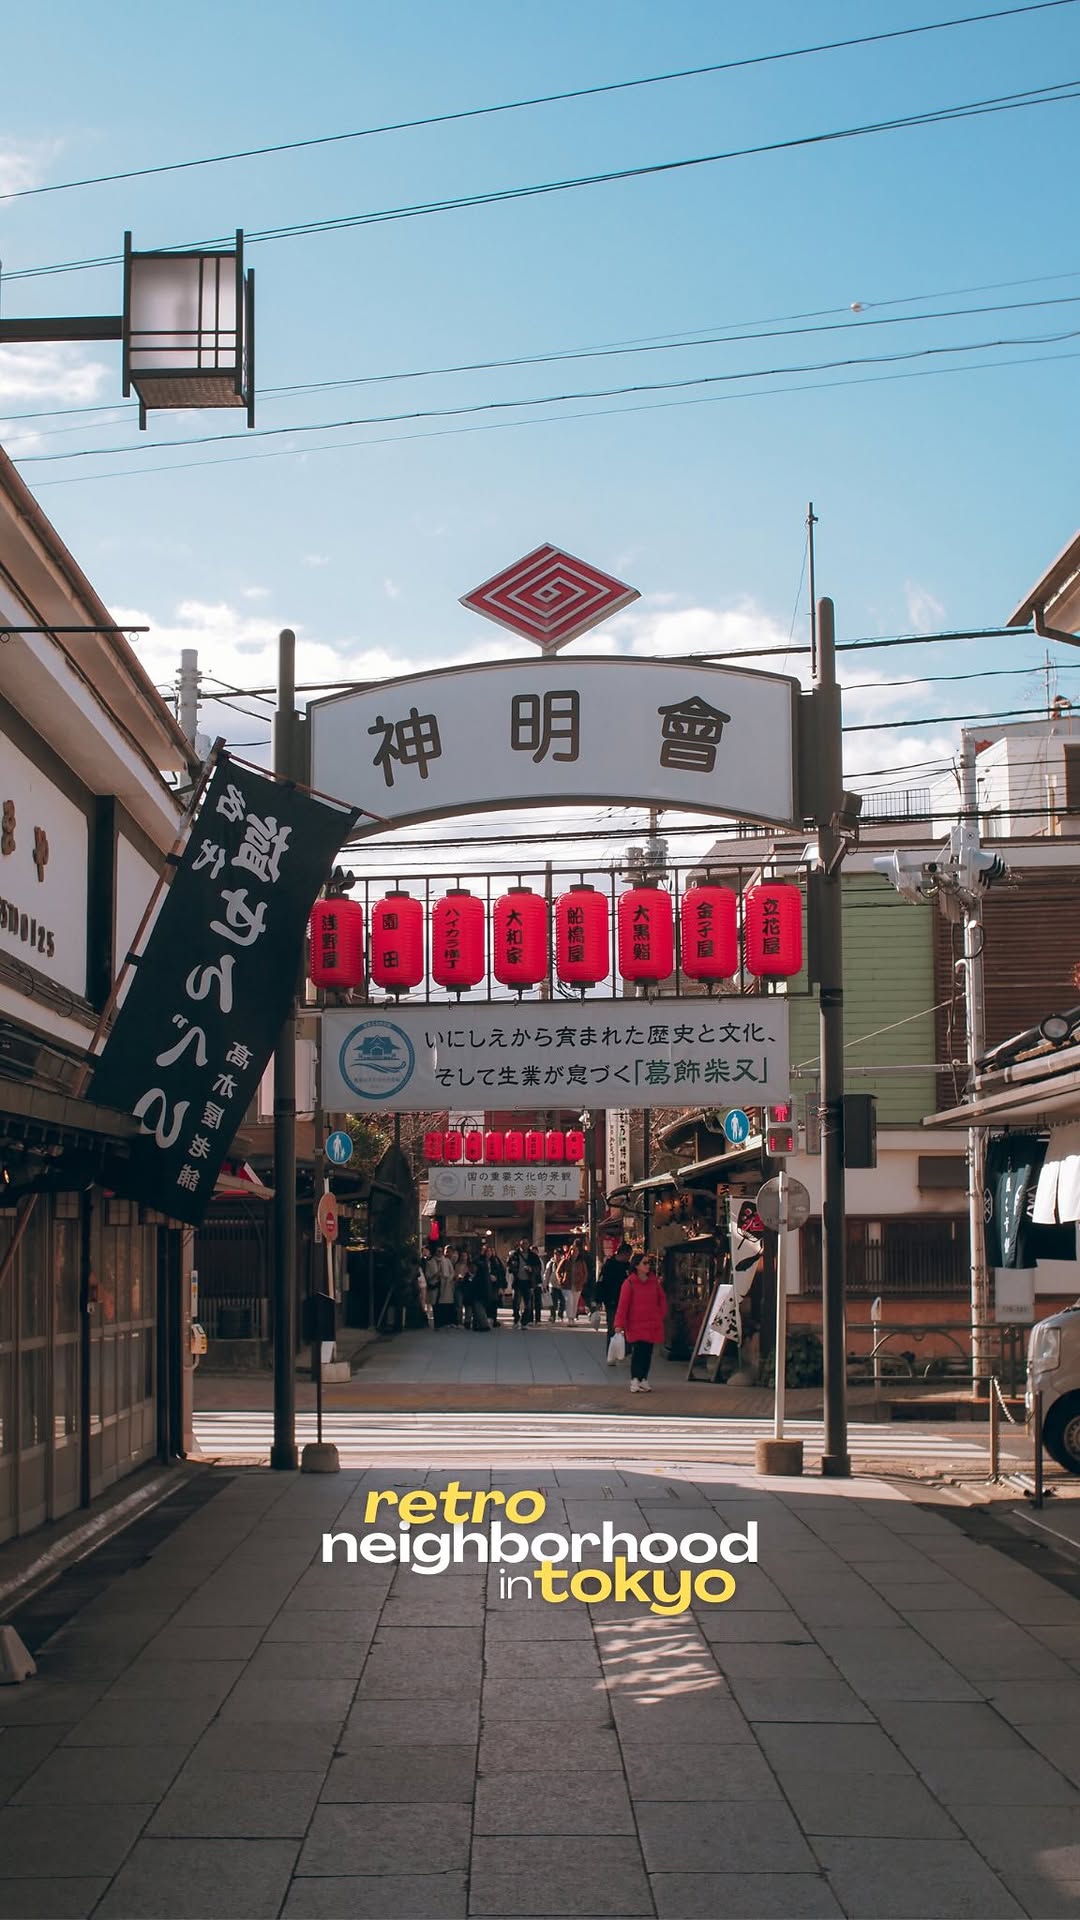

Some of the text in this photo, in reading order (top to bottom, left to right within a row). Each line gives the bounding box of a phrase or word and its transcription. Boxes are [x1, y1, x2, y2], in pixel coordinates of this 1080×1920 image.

[367, 689, 731, 786] 神明會
[382, 913, 399, 968] 園田
[445, 908, 461, 969] ハイカラ横丁
[506, 909, 523, 964] 大和家
[566, 907, 584, 962] 船橋屋
[696, 902, 714, 958] 金子屋
[762, 899, 780, 956] 立花屋
[425, 1022, 776, 1050] いにしえから育まれた歴史と文化、
[436, 1058, 768, 1087] そして生業が息づく「葛飾柴又」
